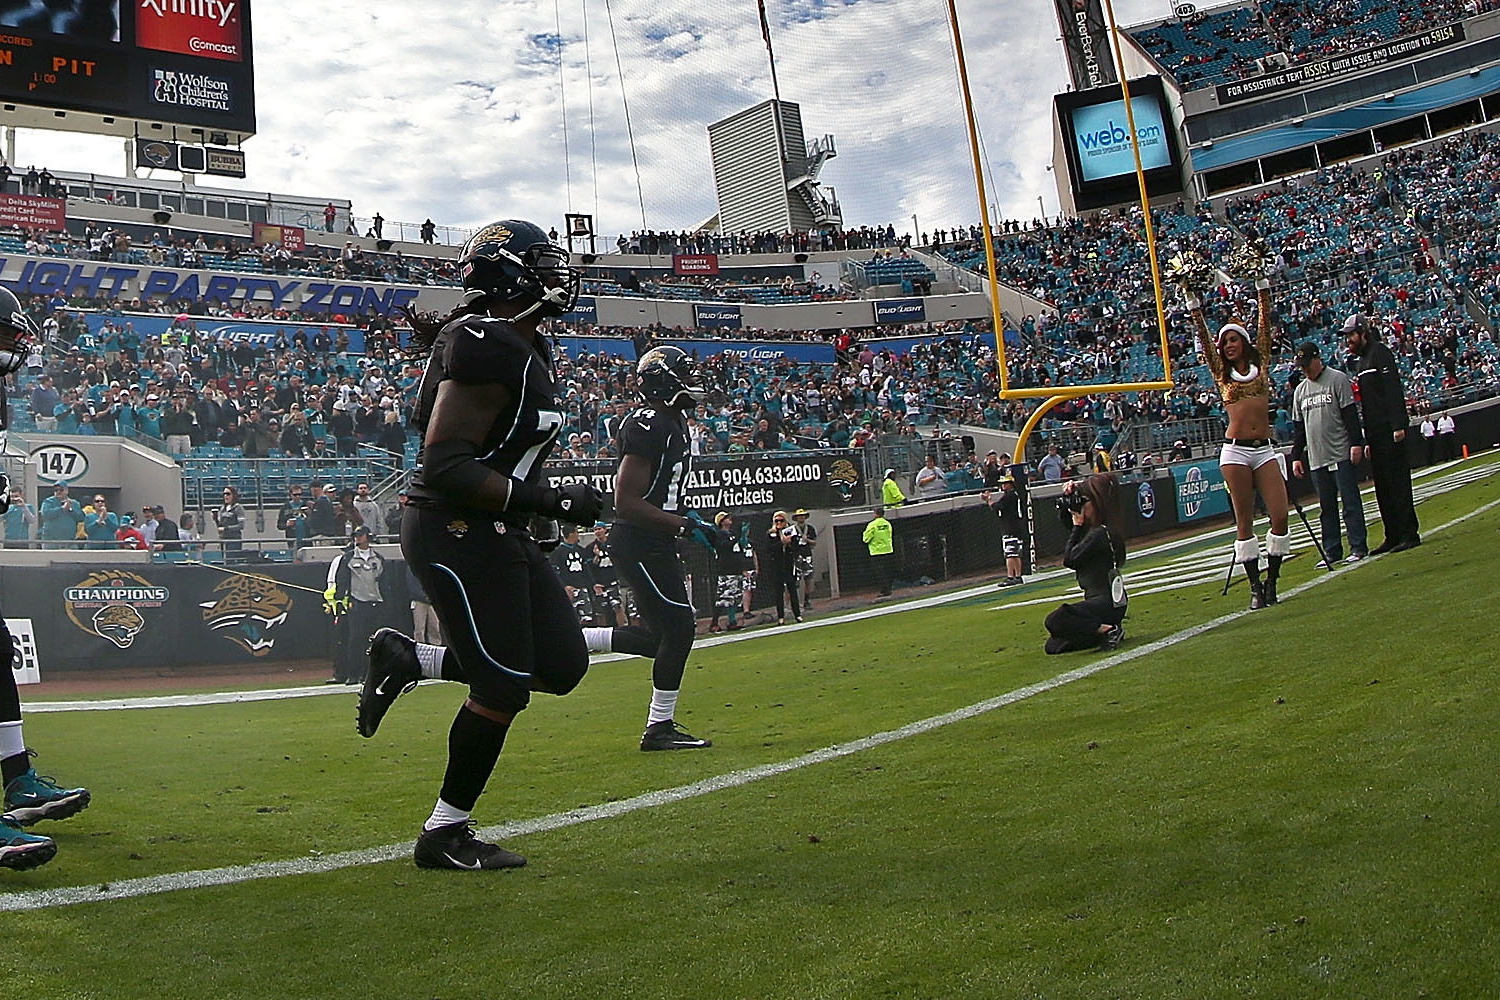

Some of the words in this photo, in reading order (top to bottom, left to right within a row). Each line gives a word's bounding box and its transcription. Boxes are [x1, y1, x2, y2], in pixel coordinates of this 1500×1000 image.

[1177, 3, 1194, 16] 403
[1076, 11, 1097, 68] EverBank
[53, 56, 96, 77] PIT
[1227, 84, 1243, 97] FOR
[1243, 75, 1287, 94] ASSISTANCE
[1286, 70, 1303, 83] TEXT
[1303, 60, 1331, 78] ASSIST
[1332, 58, 1351, 70] WITH
[1351, 52, 1372, 66] ISSUE
[1388, 40, 1421, 56] LOCATION
[1421, 36, 1431, 46] TO
[179, 73, 228, 92] Wolfson
[180, 95, 230, 111] HOSPITAL
[1079, 120, 1160, 150] web.om
[211, 155, 242, 166] BUBBA
[8, 198, 27, 206] Delta
[28, 200, 60, 209] SkyMiles
[17, 207, 35, 215] Card
[29, 215, 57, 225] Express
[140, 271, 303, 309] PARTY
[301, 283, 420, 319] ZONE
[699, 312, 716, 320] BUD
[717, 312, 740, 320] LIGHT
[878, 306, 897, 315] BUD
[900, 304, 923, 313] LIGHT
[217, 330, 275, 344] LIGHT
[752, 349, 785, 360] LIGHT
[632, 408, 656, 420] 14
[40, 452, 77, 475] 147
[687, 469, 720, 490] ALL
[724, 464, 821, 482] 904.633.2000
[1179, 482, 1199, 497] HEADS
[1199, 480, 1209, 493] UP
[1025, 478, 1037, 573] JAGUARS
[68, 588, 165, 601] CHAMPIONS
